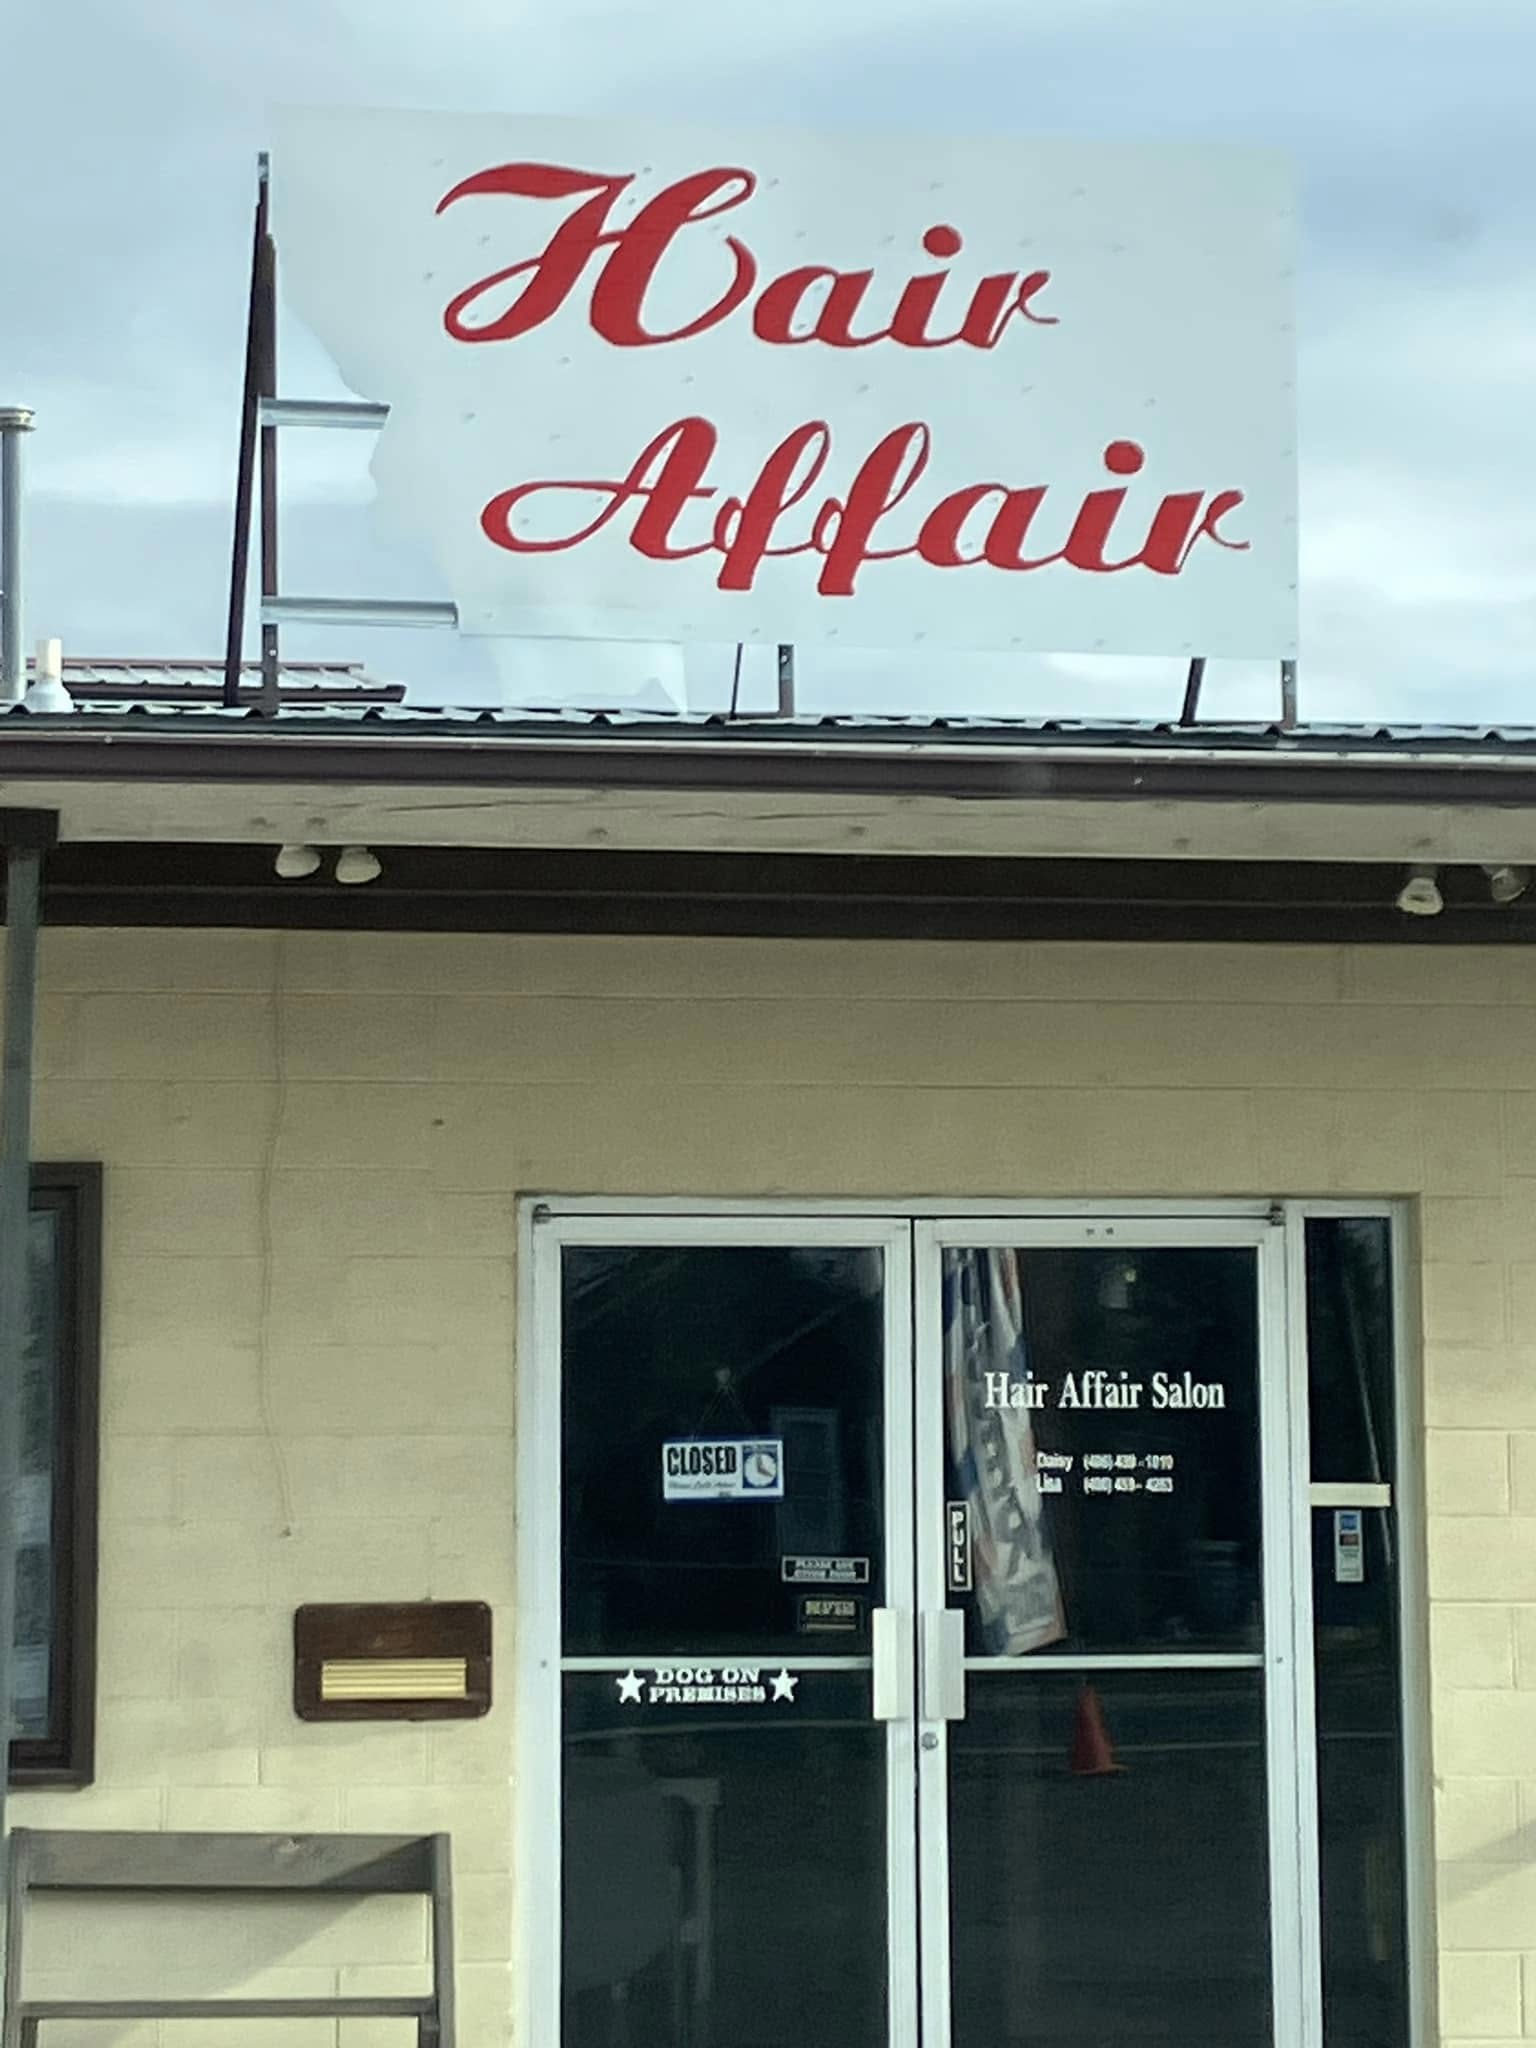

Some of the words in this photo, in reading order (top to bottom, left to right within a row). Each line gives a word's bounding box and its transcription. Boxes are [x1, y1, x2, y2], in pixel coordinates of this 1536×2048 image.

[435, 162, 1060, 350] Hair
[479, 415, 1251, 597] Affair
[984, 1371, 1049, 1408] Hair
[1058, 1371, 1143, 1408] Affair
[1151, 1371, 1226, 1408] Salon
[667, 1446, 737, 1476] CLOSED
[950, 1511, 966, 1583] PULL
[648, 1685, 767, 1703] PREMISES
[654, 1667, 715, 1684] DOG
[721, 1667, 762, 1684] ON
